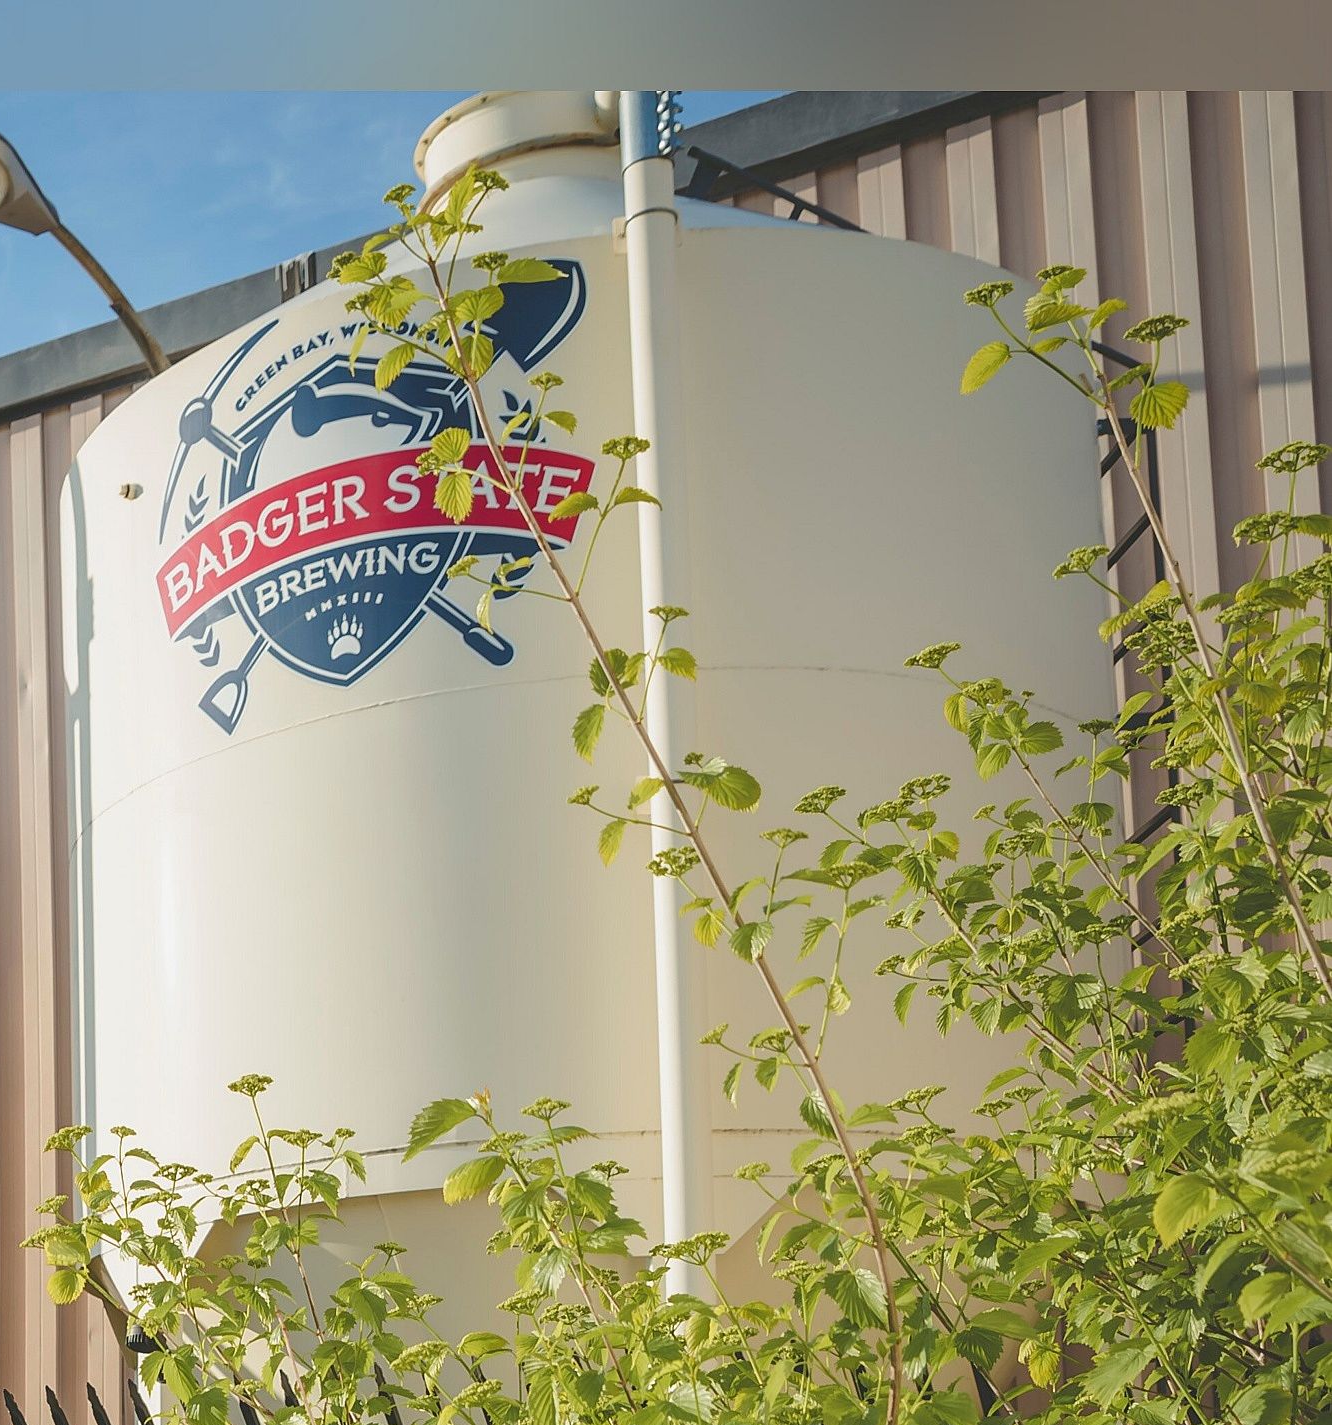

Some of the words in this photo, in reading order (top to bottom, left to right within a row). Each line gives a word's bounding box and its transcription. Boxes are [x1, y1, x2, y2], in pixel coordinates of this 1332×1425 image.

[235, 354, 290, 412] GREEN
[292, 331, 335, 360] BAY,
[164, 475, 370, 614] BADGER
[383, 460, 581, 514] SATE
[255, 542, 440, 617] BREWING
[304, 592, 384, 622] MMXIII
